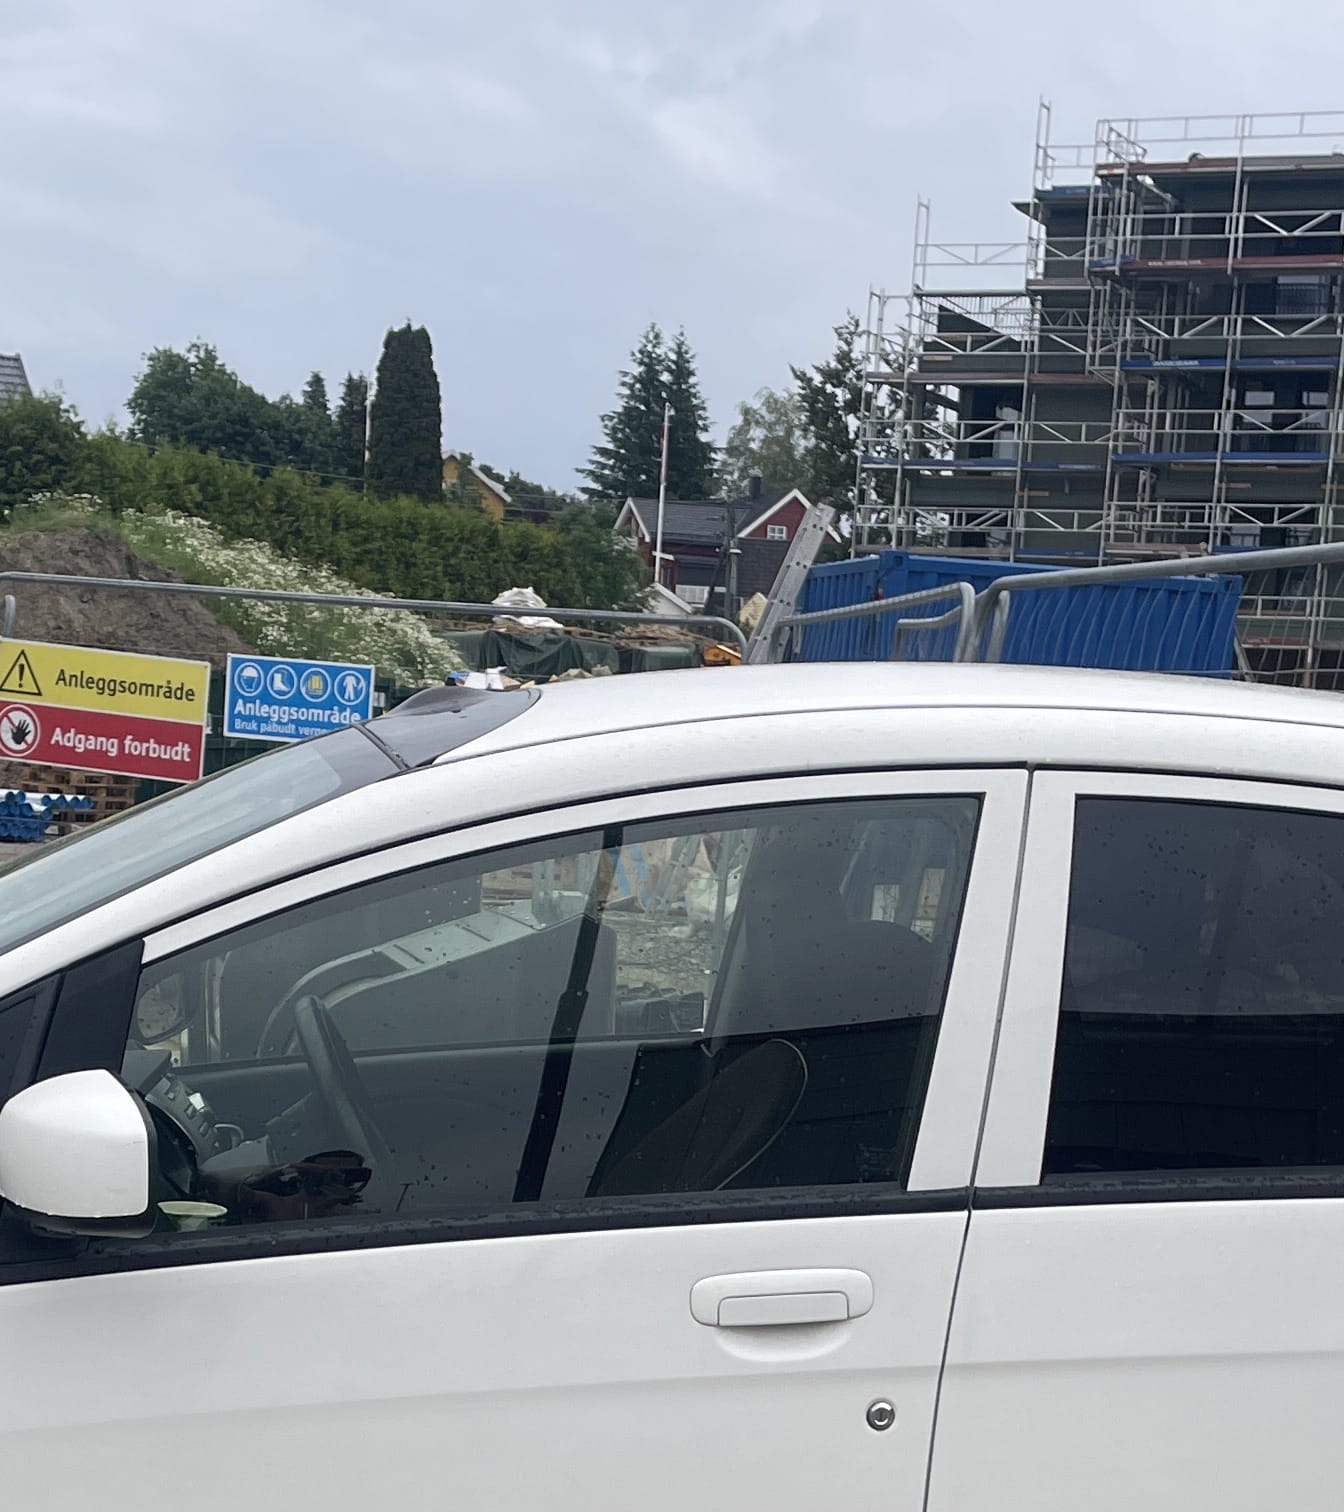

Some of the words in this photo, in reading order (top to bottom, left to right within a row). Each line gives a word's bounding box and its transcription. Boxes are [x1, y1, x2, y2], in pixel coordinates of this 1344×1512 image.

[55, 669, 195, 701] Anleggsområde
[234, 699, 361, 724] Anleggsområde
[234, 719, 258, 730] Bruk
[260, 721, 296, 734] påbudt
[51, 727, 118, 756] Adgang
[124, 735, 191, 761] forbudt
